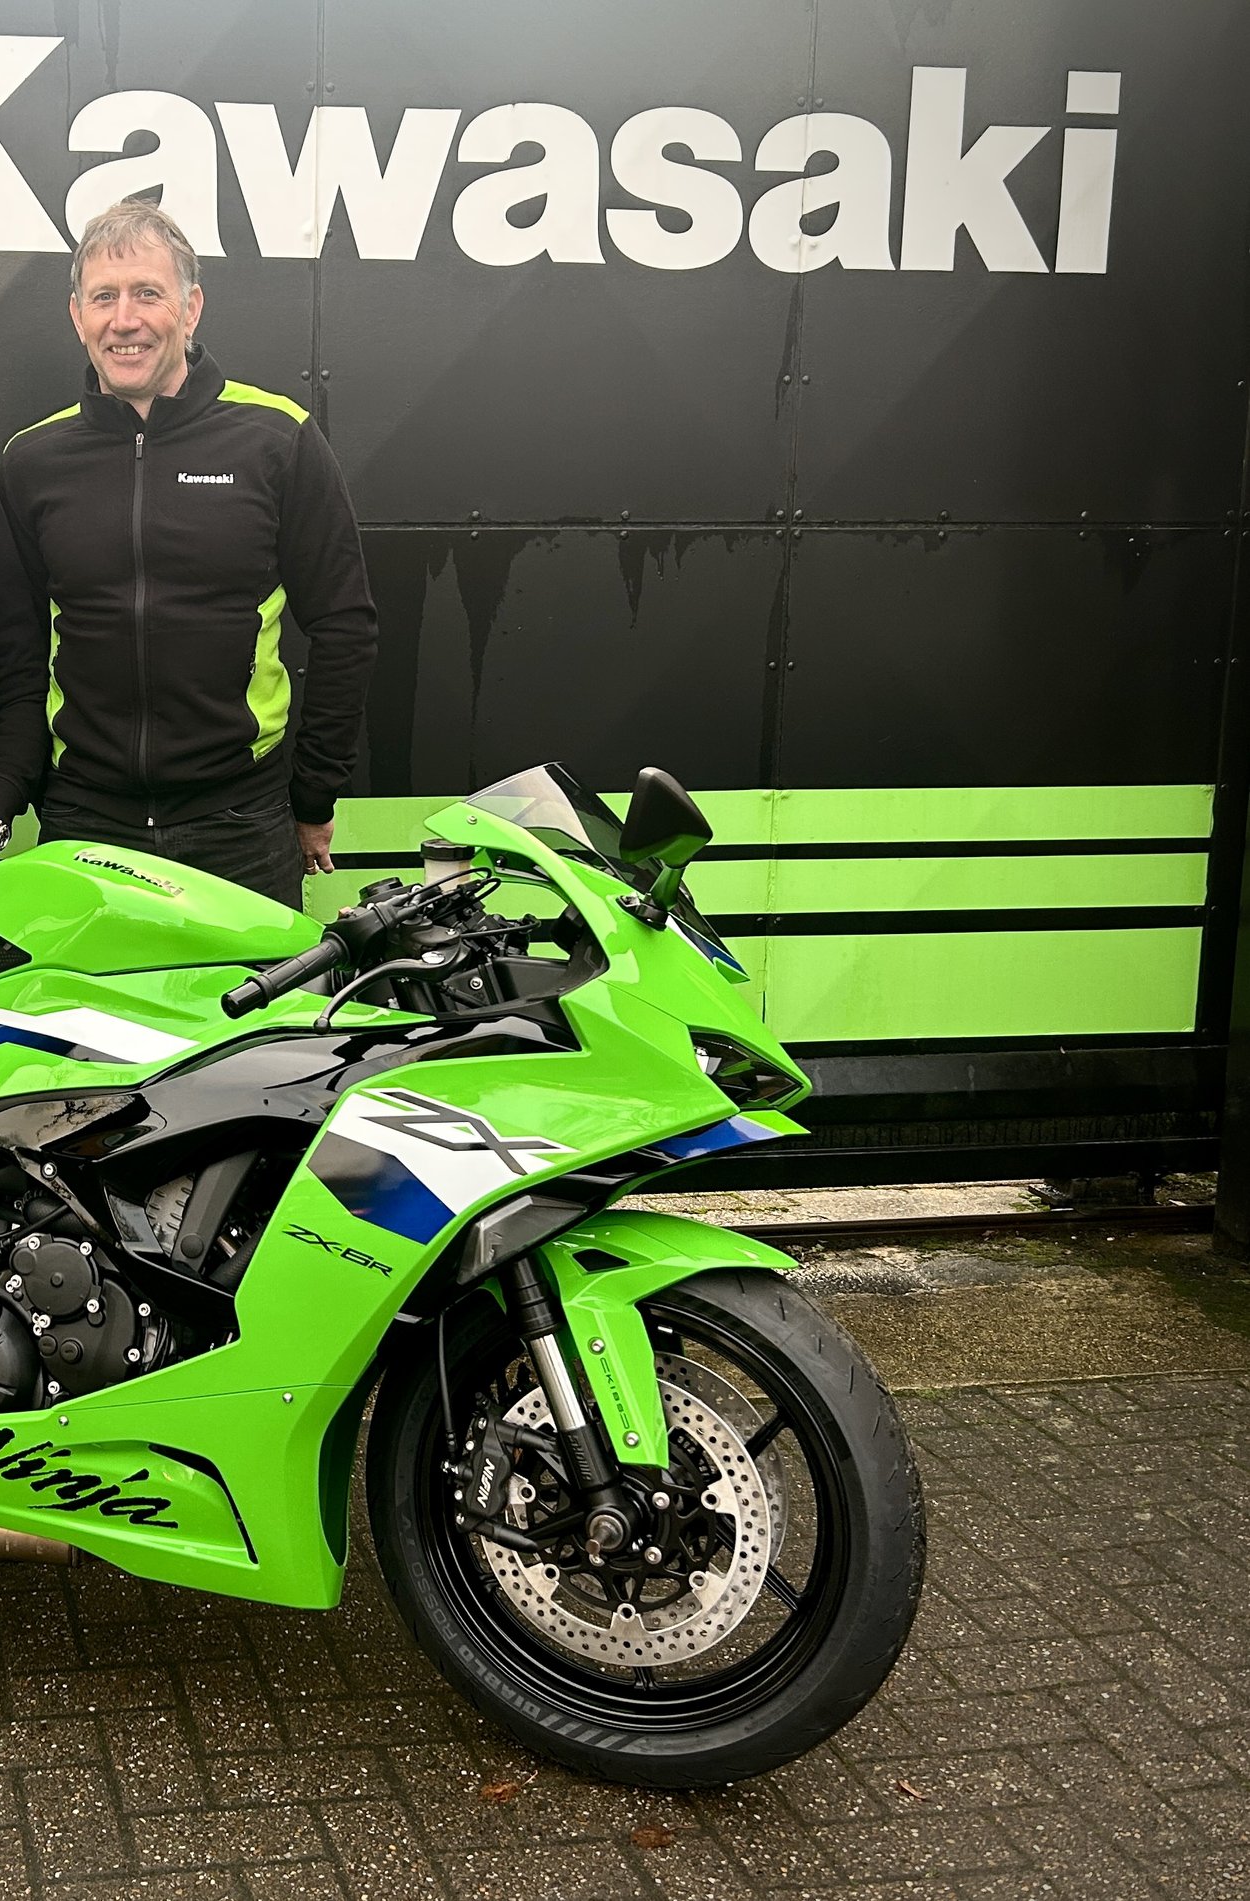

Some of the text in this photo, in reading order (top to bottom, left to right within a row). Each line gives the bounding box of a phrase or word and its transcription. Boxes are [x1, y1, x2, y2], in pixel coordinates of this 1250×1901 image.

[177, 472, 234, 484] Kawasaki
[358, 1090, 562, 1176] ZX
[282, 1223, 394, 1278] ZX-6R
[411, 1561, 458, 1641] ROSSO
[458, 1644, 541, 1719] DIABLO
